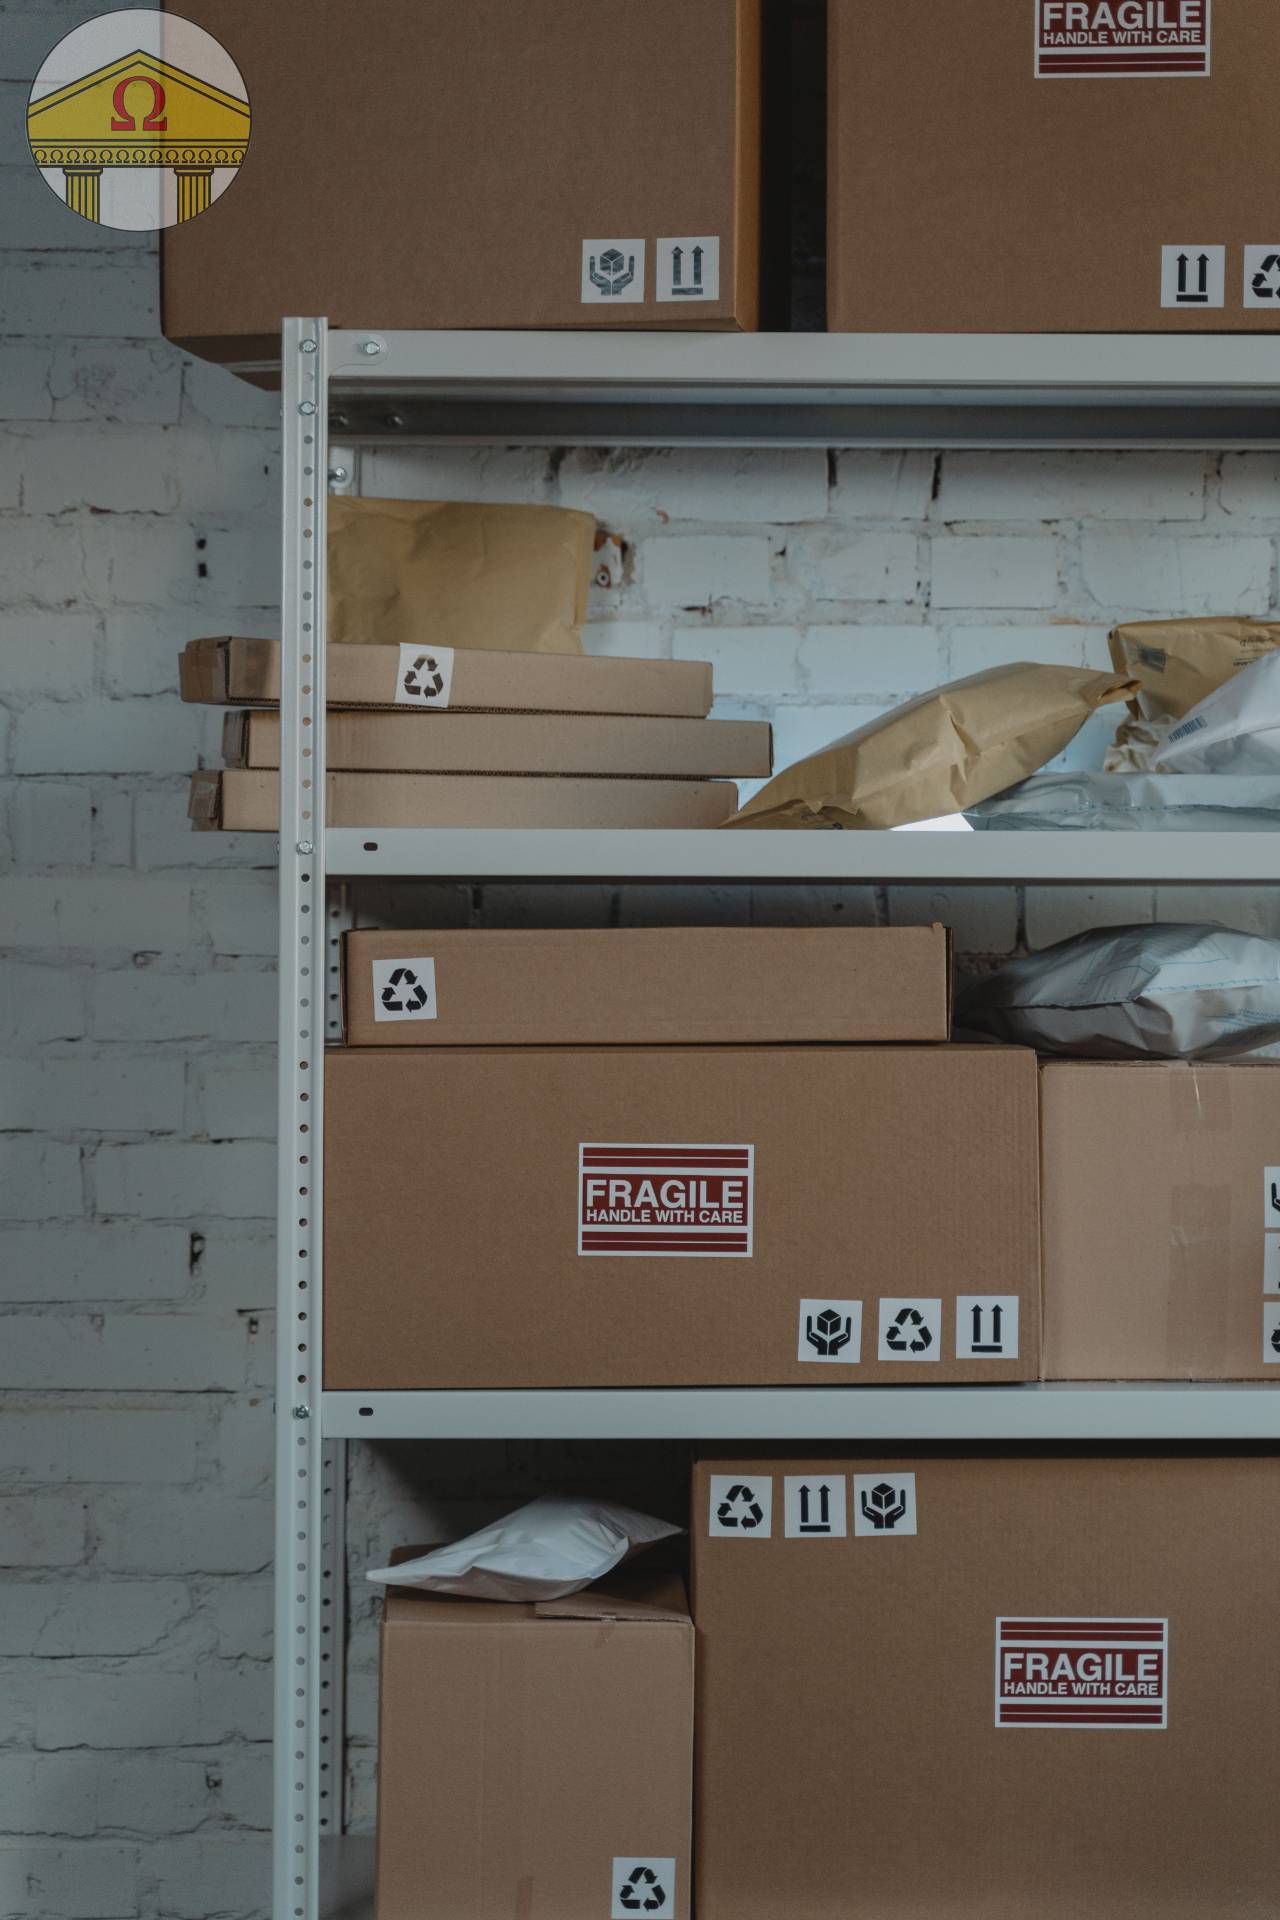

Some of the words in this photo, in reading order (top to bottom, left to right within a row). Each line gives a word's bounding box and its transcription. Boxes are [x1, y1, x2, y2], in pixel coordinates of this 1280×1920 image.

[1043, 1, 1202, 30] FRAGILE
[1044, 31, 1108, 44] HANDLE
[1113, 31, 1152, 44] WITH
[1156, 30, 1201, 43] CARE
[586, 1179, 744, 1209] FRAGILE
[586, 1209, 651, 1222] HANDLE
[655, 1210, 695, 1223] WITH
[699, 1210, 743, 1223] CARE
[1004, 1652, 1159, 1681] FRAGILE
[1004, 1682, 1068, 1695] HANDLE
[1072, 1682, 1110, 1695] WITH
[1114, 1683, 1158, 1696] CARE
